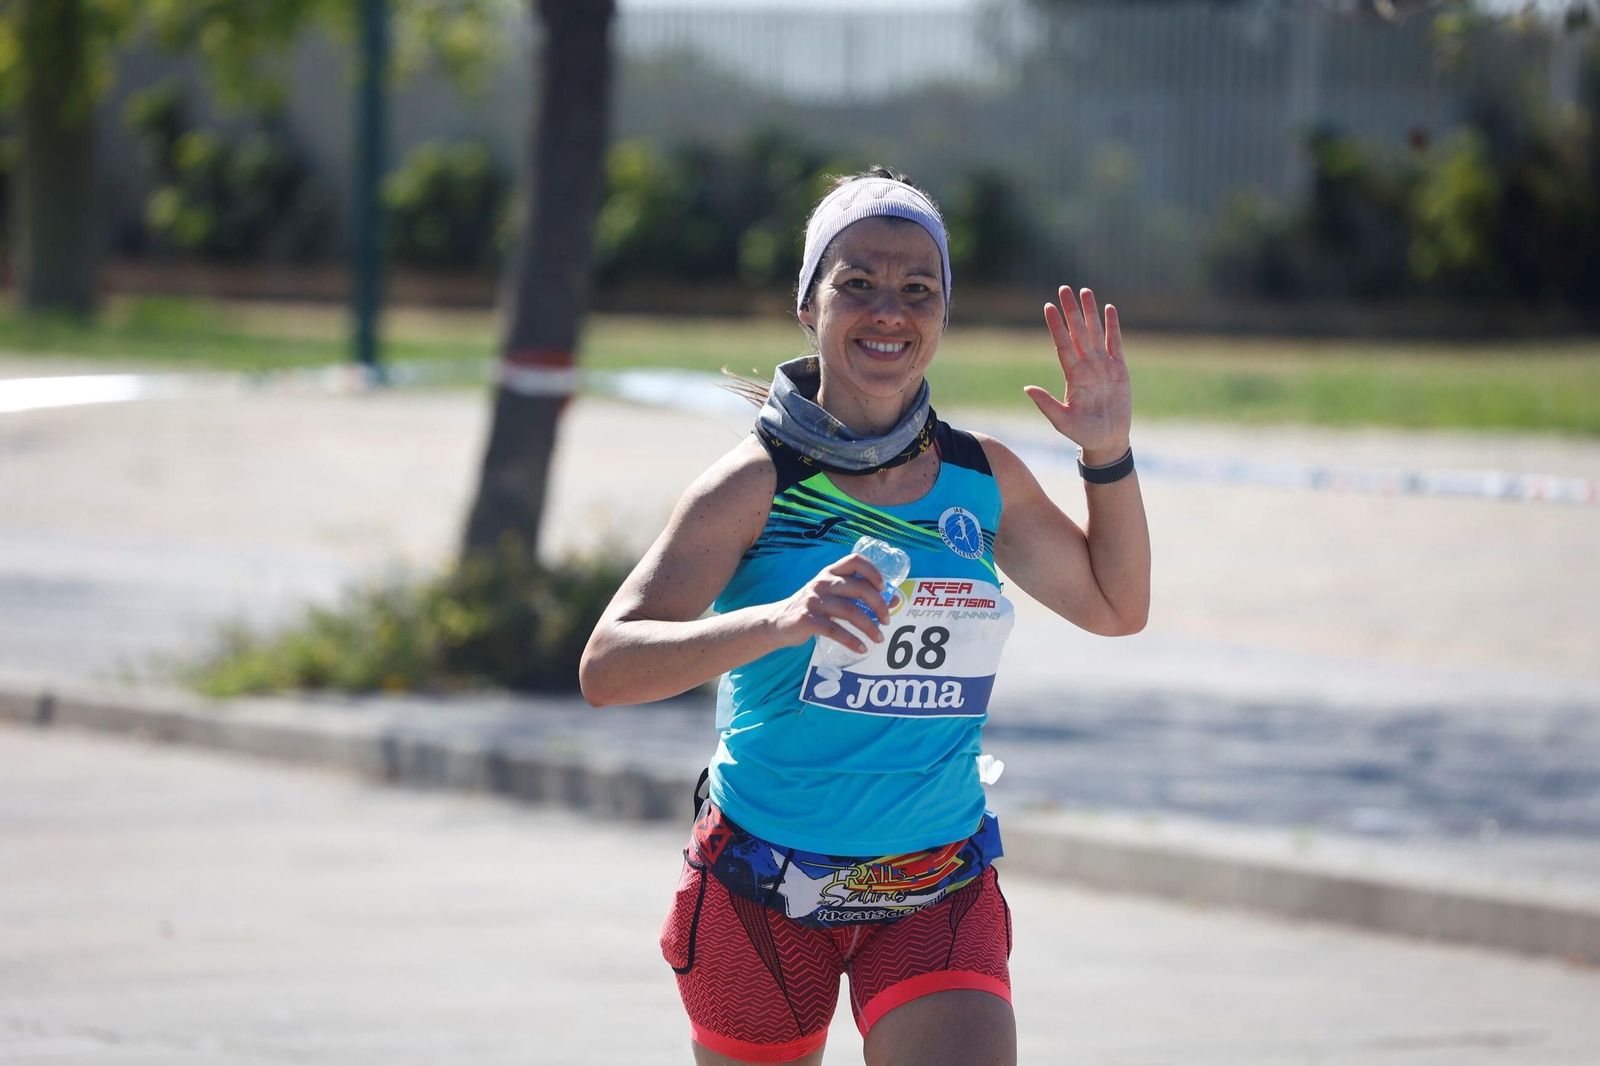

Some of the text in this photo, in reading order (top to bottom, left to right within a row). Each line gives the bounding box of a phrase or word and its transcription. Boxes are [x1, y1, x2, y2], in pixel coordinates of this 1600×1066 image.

[917, 581, 973, 596] RFEA
[913, 597, 996, 609] ATLETISMO
[906, 609, 1001, 620] RUTA RUNNING
[886, 625, 950, 670] 68
